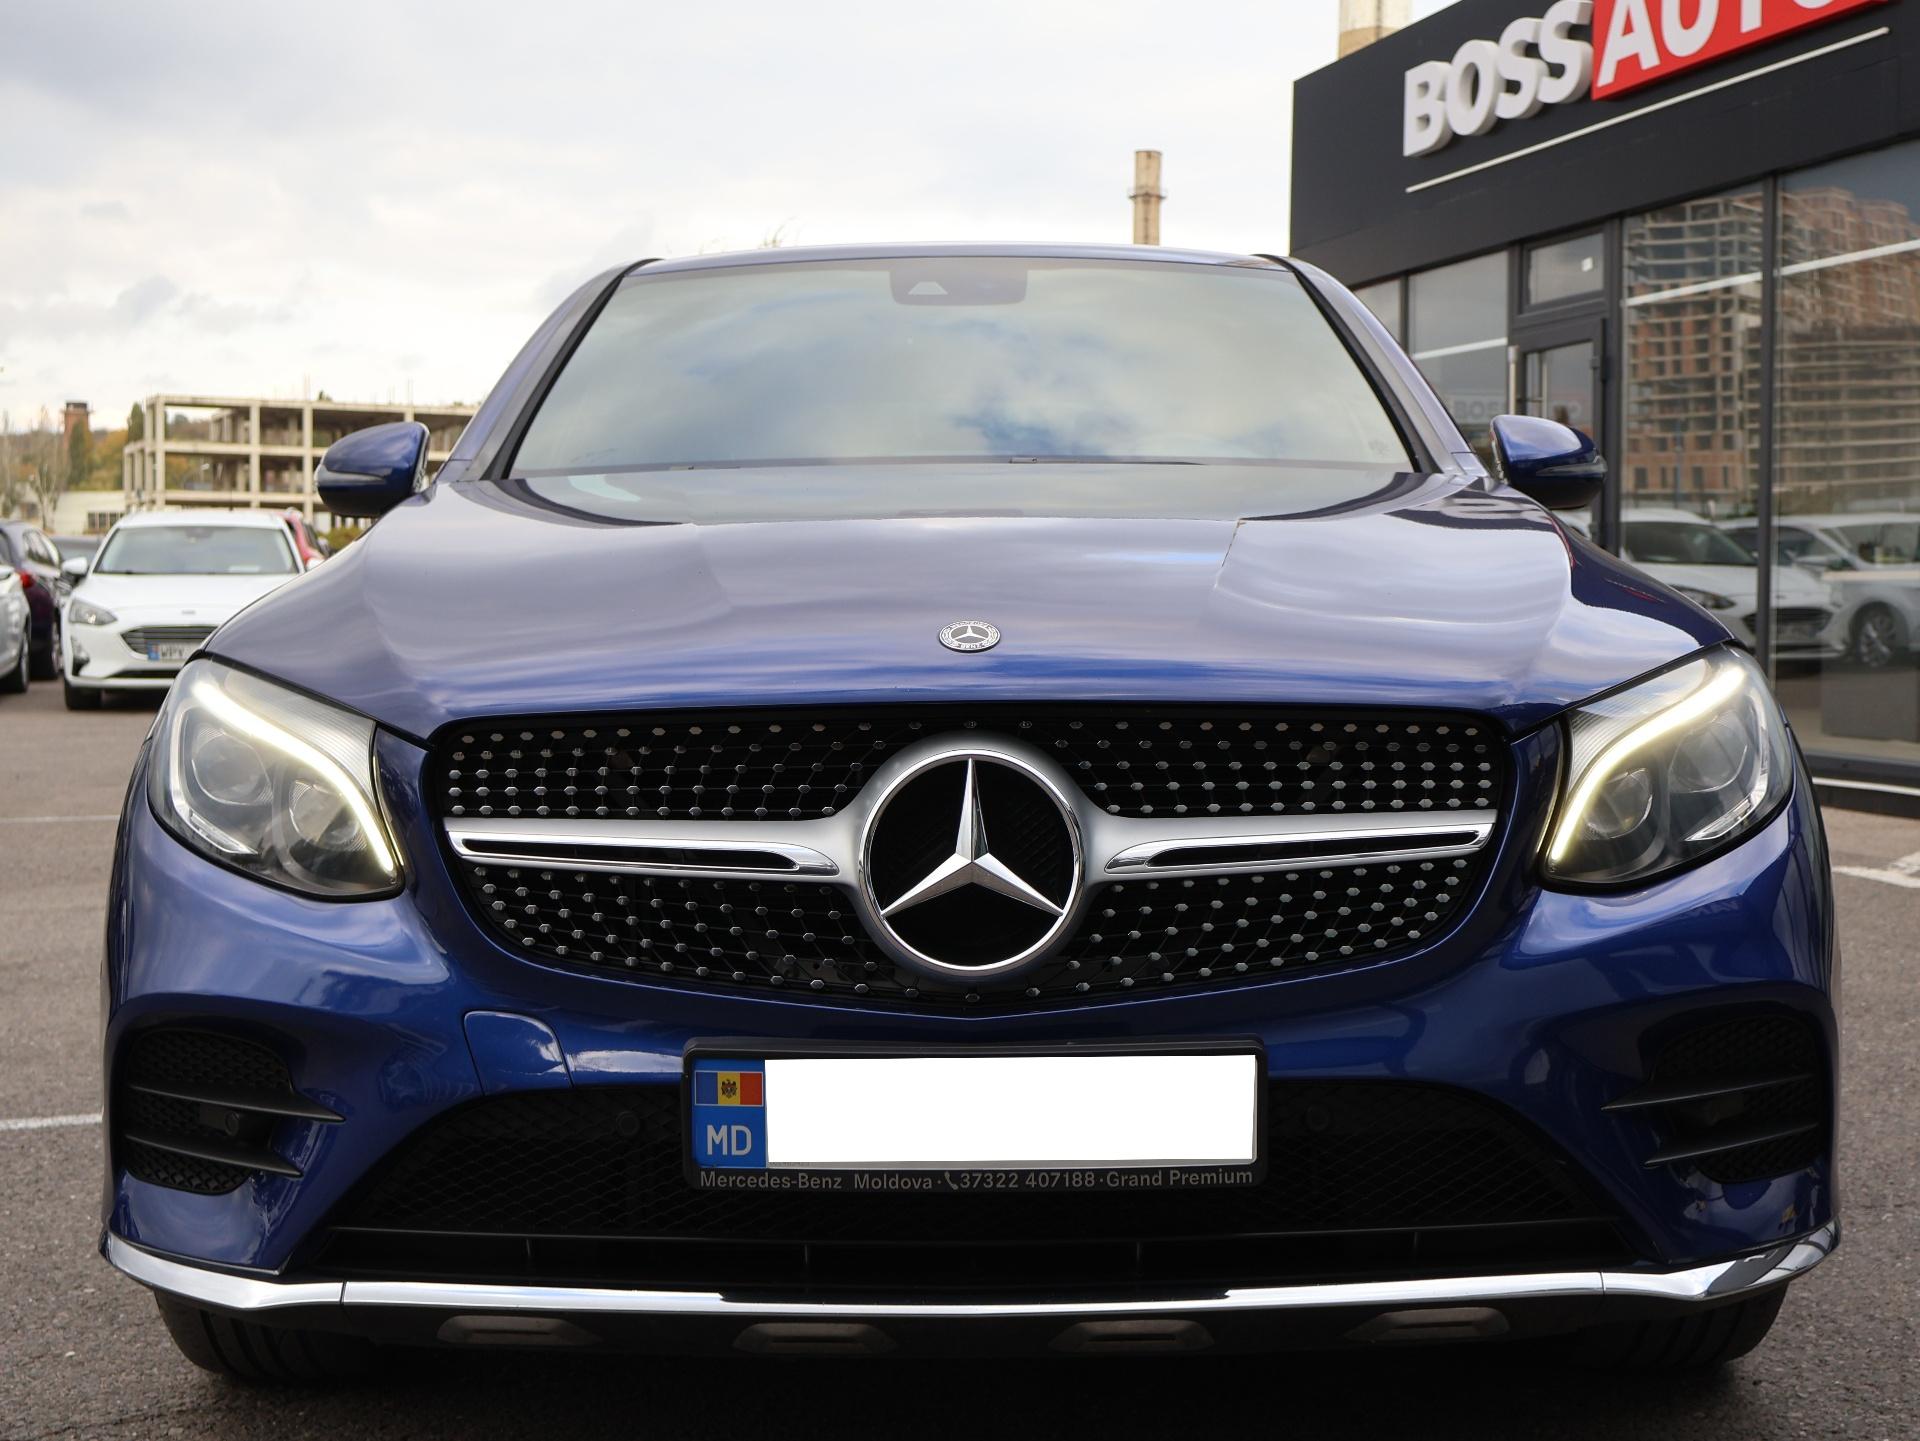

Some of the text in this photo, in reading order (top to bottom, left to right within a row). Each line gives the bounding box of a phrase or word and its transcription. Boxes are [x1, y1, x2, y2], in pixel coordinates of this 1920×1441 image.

[1403, 0, 1834, 157] BOSS AU
[706, 1124, 752, 1156] MD
[701, 1168, 1253, 1190] Mercedes-Benz Moldova 37322 407188 Grand Premium
